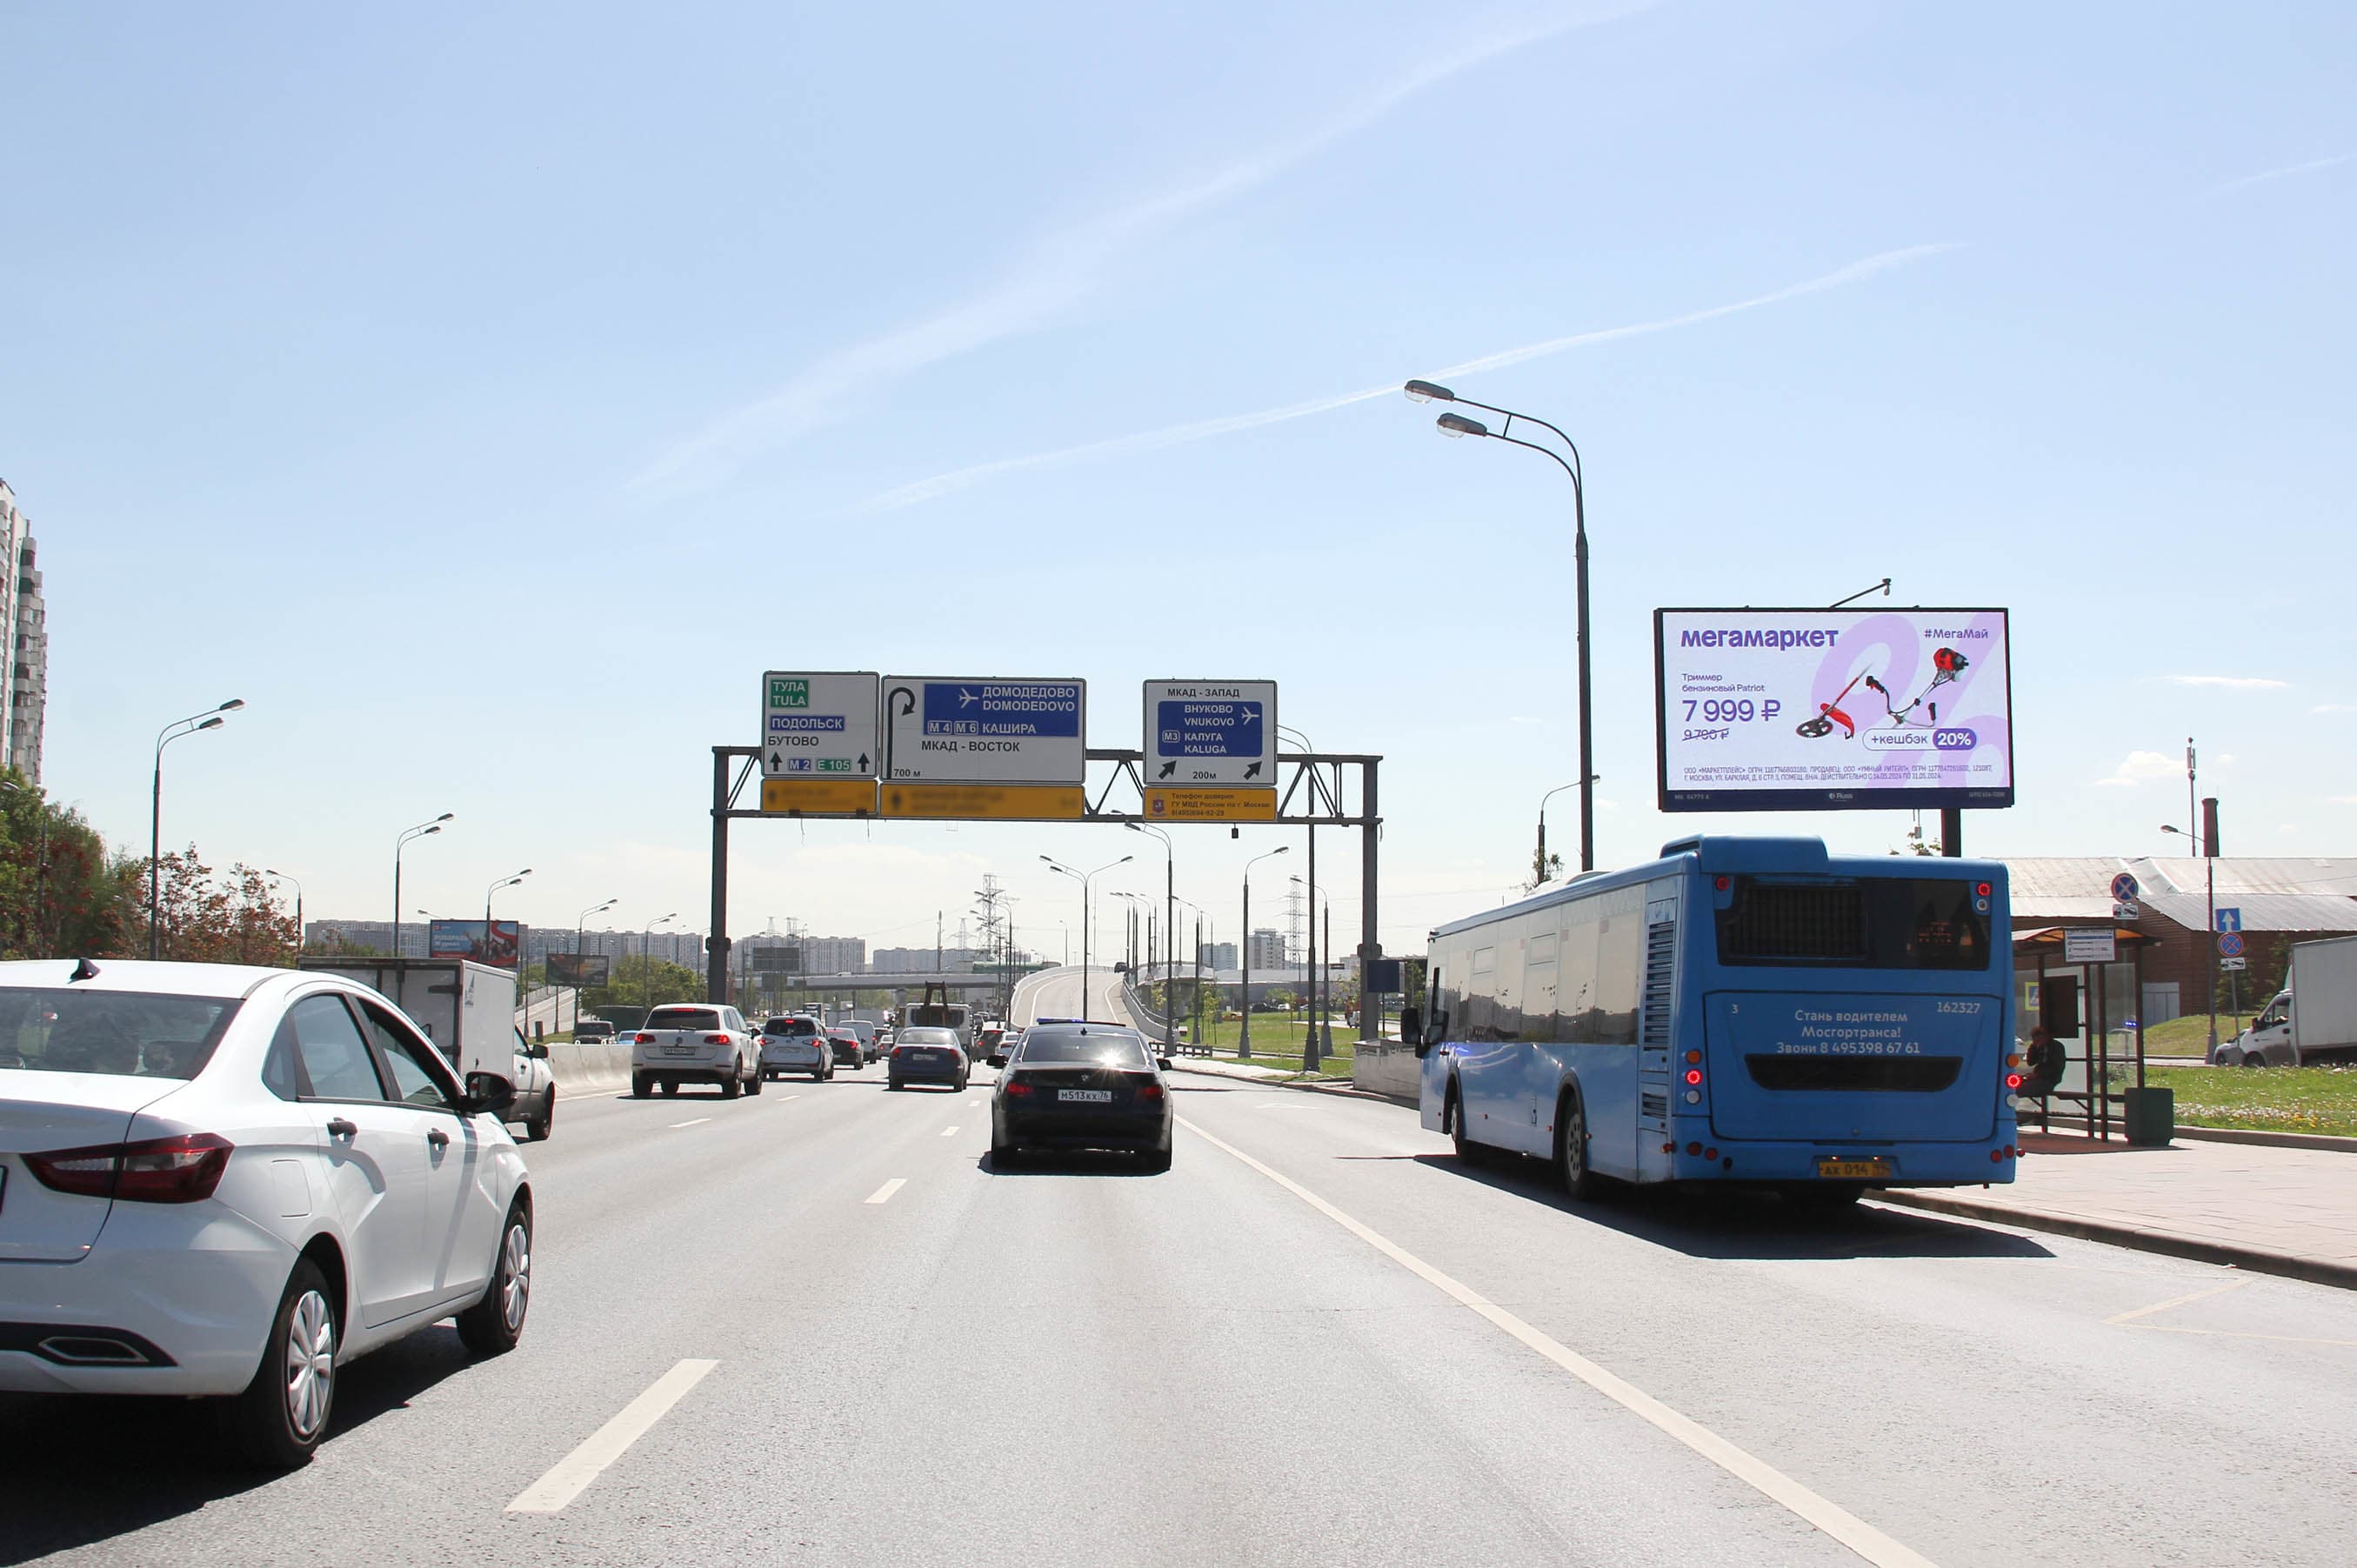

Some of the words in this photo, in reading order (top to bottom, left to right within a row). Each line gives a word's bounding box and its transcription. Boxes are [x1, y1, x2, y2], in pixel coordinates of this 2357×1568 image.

[1924, 628, 1988, 640] #МегаМай
[1681, 630, 1839, 651] мегамаркет
[1682, 673, 1723, 682] Триммер
[772, 682, 806, 692] ТУЛА
[982, 686, 1075, 698] ДОМОДЕДОВО
[1682, 684, 1735, 692] бензиновый
[1737, 684, 1766, 692] Patriot
[1167, 688, 1197, 697] МКАД
[1205, 688, 1240, 698] ЗАПАД
[772, 695, 806, 706] TULA
[982, 700, 1075, 711] DOMODEDOVO
[1184, 704, 1233, 714] ВНУКОВО
[1682, 699, 1698, 722] 7
[1703, 699, 1754, 723] 999
[771, 717, 843, 730] ПОДОЛЬСК
[1184, 717, 1235, 727] VNUKOVO
[982, 723, 1038, 734] КАШИРА
[768, 736, 819, 746] БУТОВО
[1164, 732, 1178, 741] М3
[1184, 732, 1224, 742] КАЛУГА
[1871, 733, 1928, 744] +кешбэк
[1937, 732, 1972, 746] 20%
[921, 741, 958, 752] МКАД
[969, 741, 1021, 752] ВОСТОК
[1184, 744, 1227, 754] KALUGA
[893, 768, 911, 777] 700
[1732, 1004, 1739, 1014] 3
[1937, 1001, 1980, 1014] 162327
[1794, 1010, 1833, 1022] Стань
[1837, 1011, 1907, 1024] водителем
[1801, 1026, 1901, 1039] Мосгортранса!
[1776, 1042, 1816, 1053] Звони
